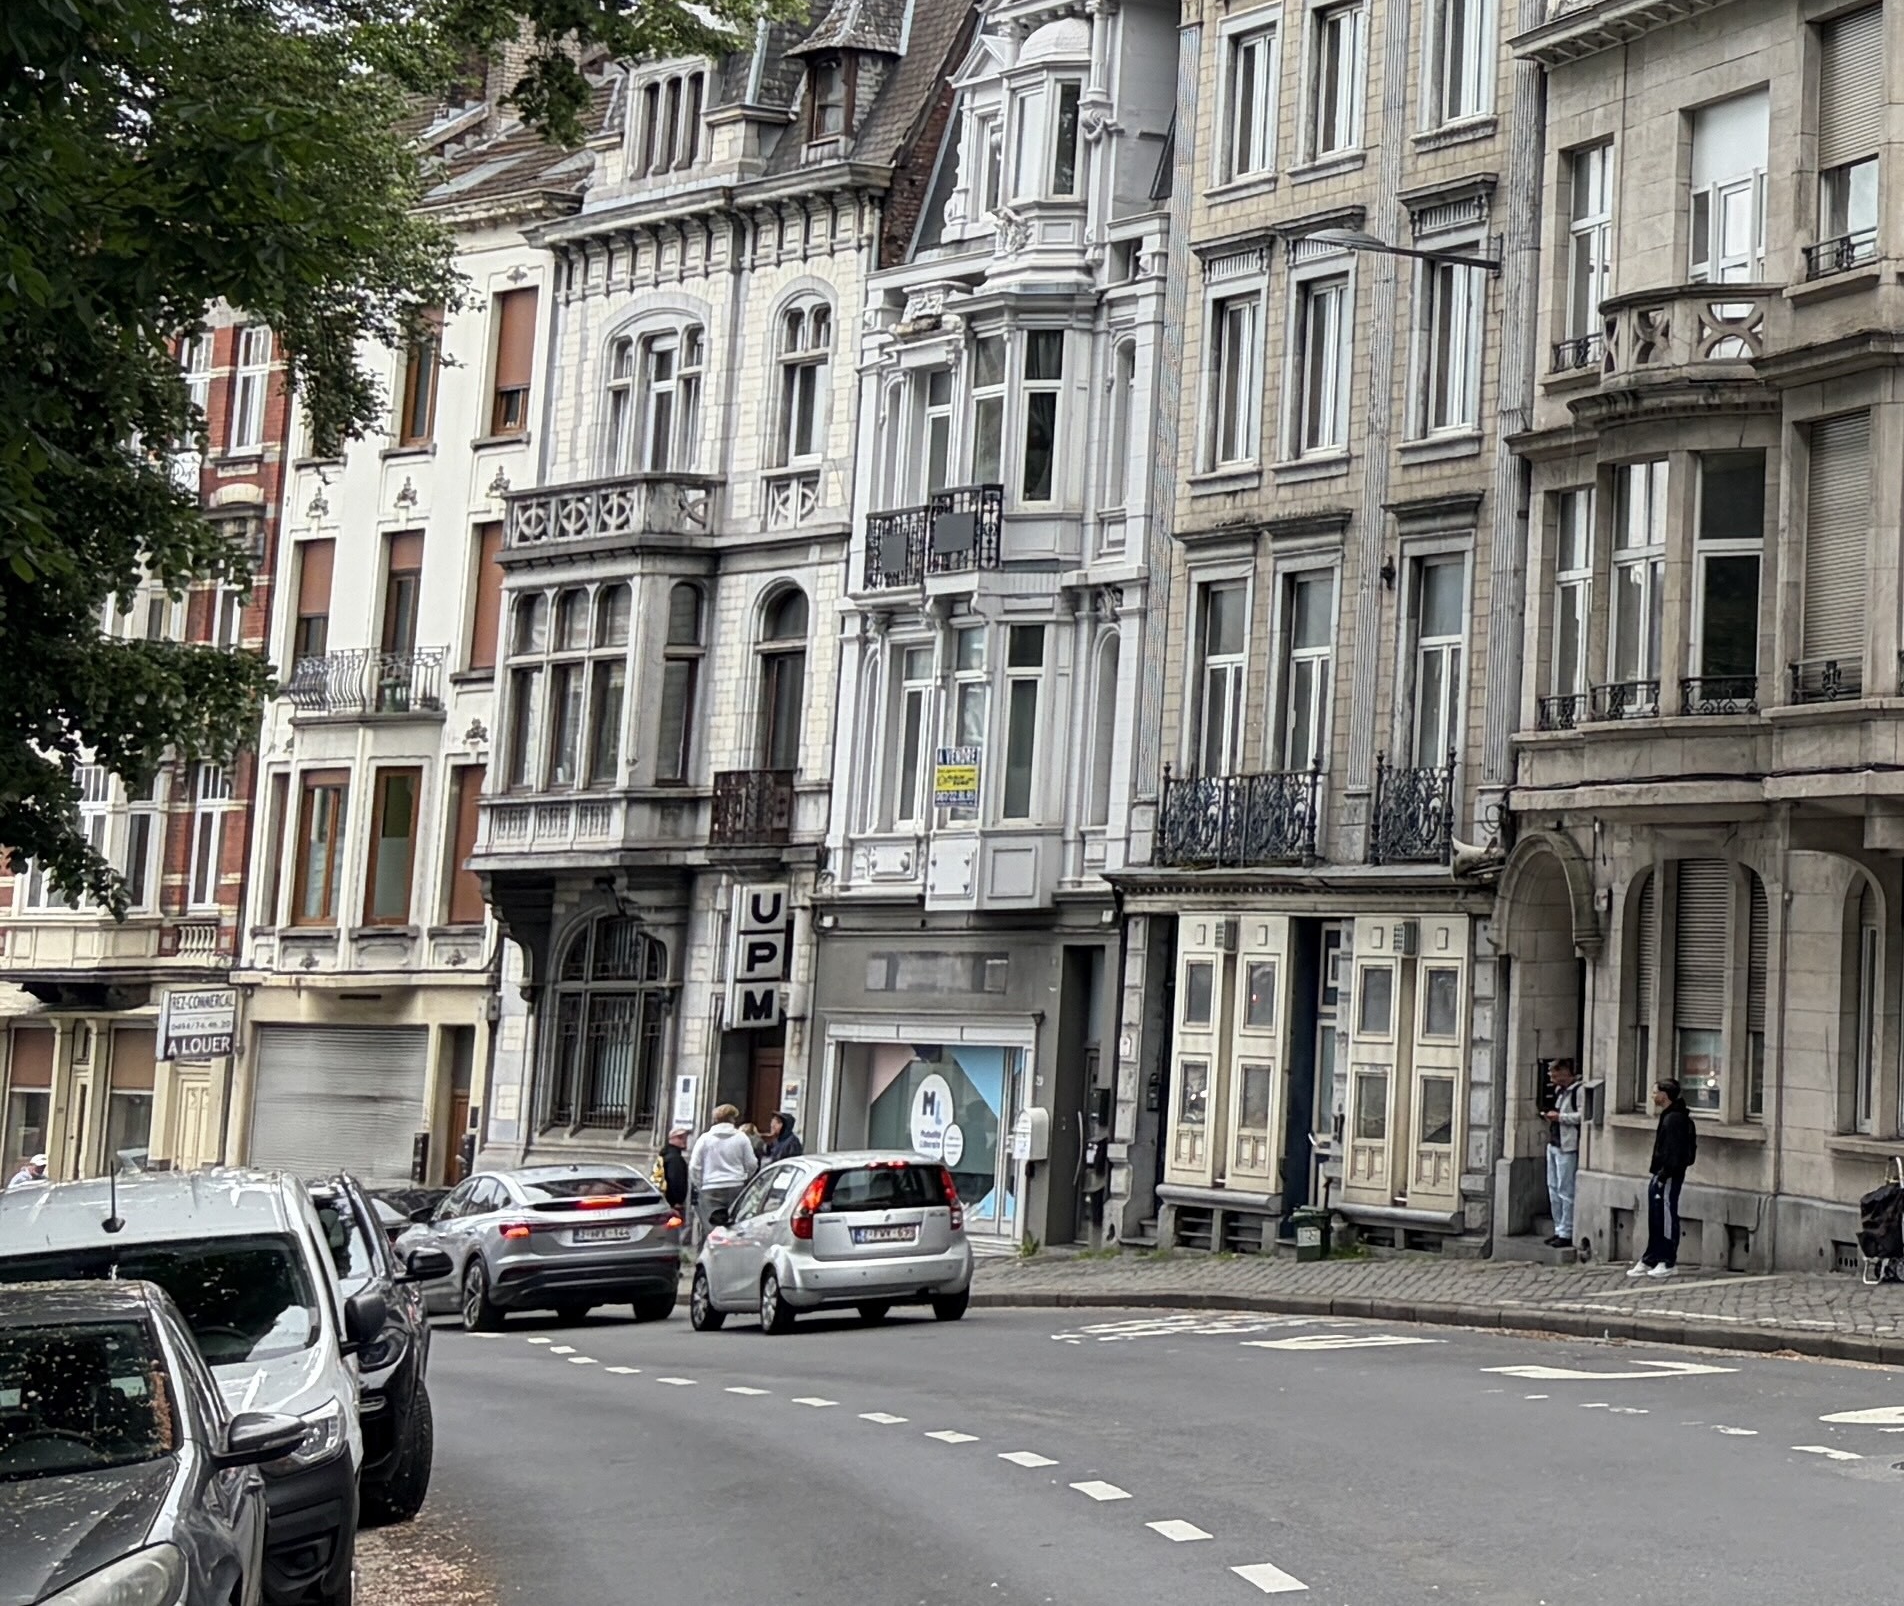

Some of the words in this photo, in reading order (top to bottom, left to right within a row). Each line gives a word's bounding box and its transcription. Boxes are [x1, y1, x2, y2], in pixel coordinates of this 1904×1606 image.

[742, 893, 782, 1021] UPM
[167, 1040, 178, 1056] A
[181, 1036, 231, 1054] LOUER
